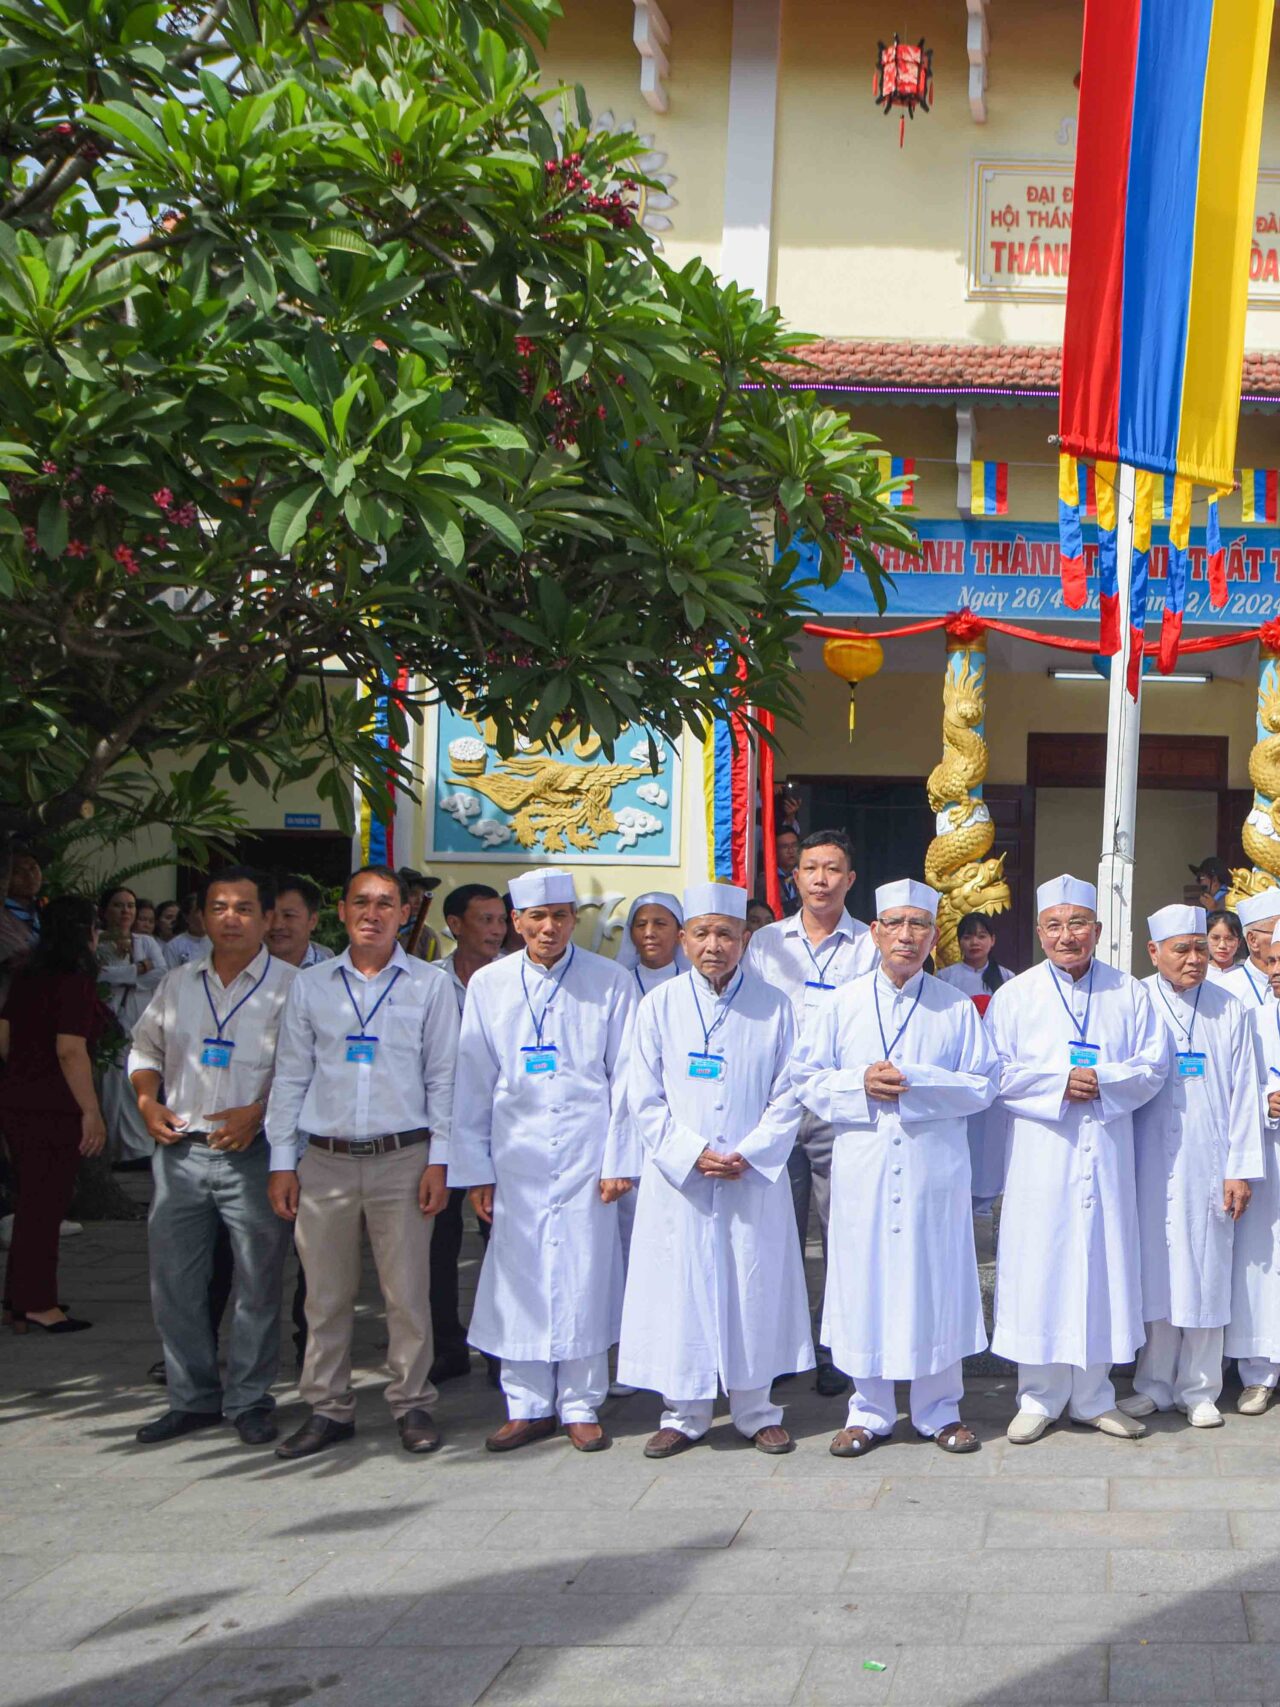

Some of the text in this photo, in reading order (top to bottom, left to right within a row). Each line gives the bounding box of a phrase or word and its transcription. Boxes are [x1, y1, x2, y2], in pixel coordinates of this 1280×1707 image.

[1026, 186, 1055, 205] ĐẠI
[991, 204, 1019, 232] HỘI
[1027, 206, 1073, 228] THÁN
[1249, 239, 1280, 282] ÒA
[1187, 535, 1265, 583] TẤT
[957, 585, 1008, 612] Ngày
